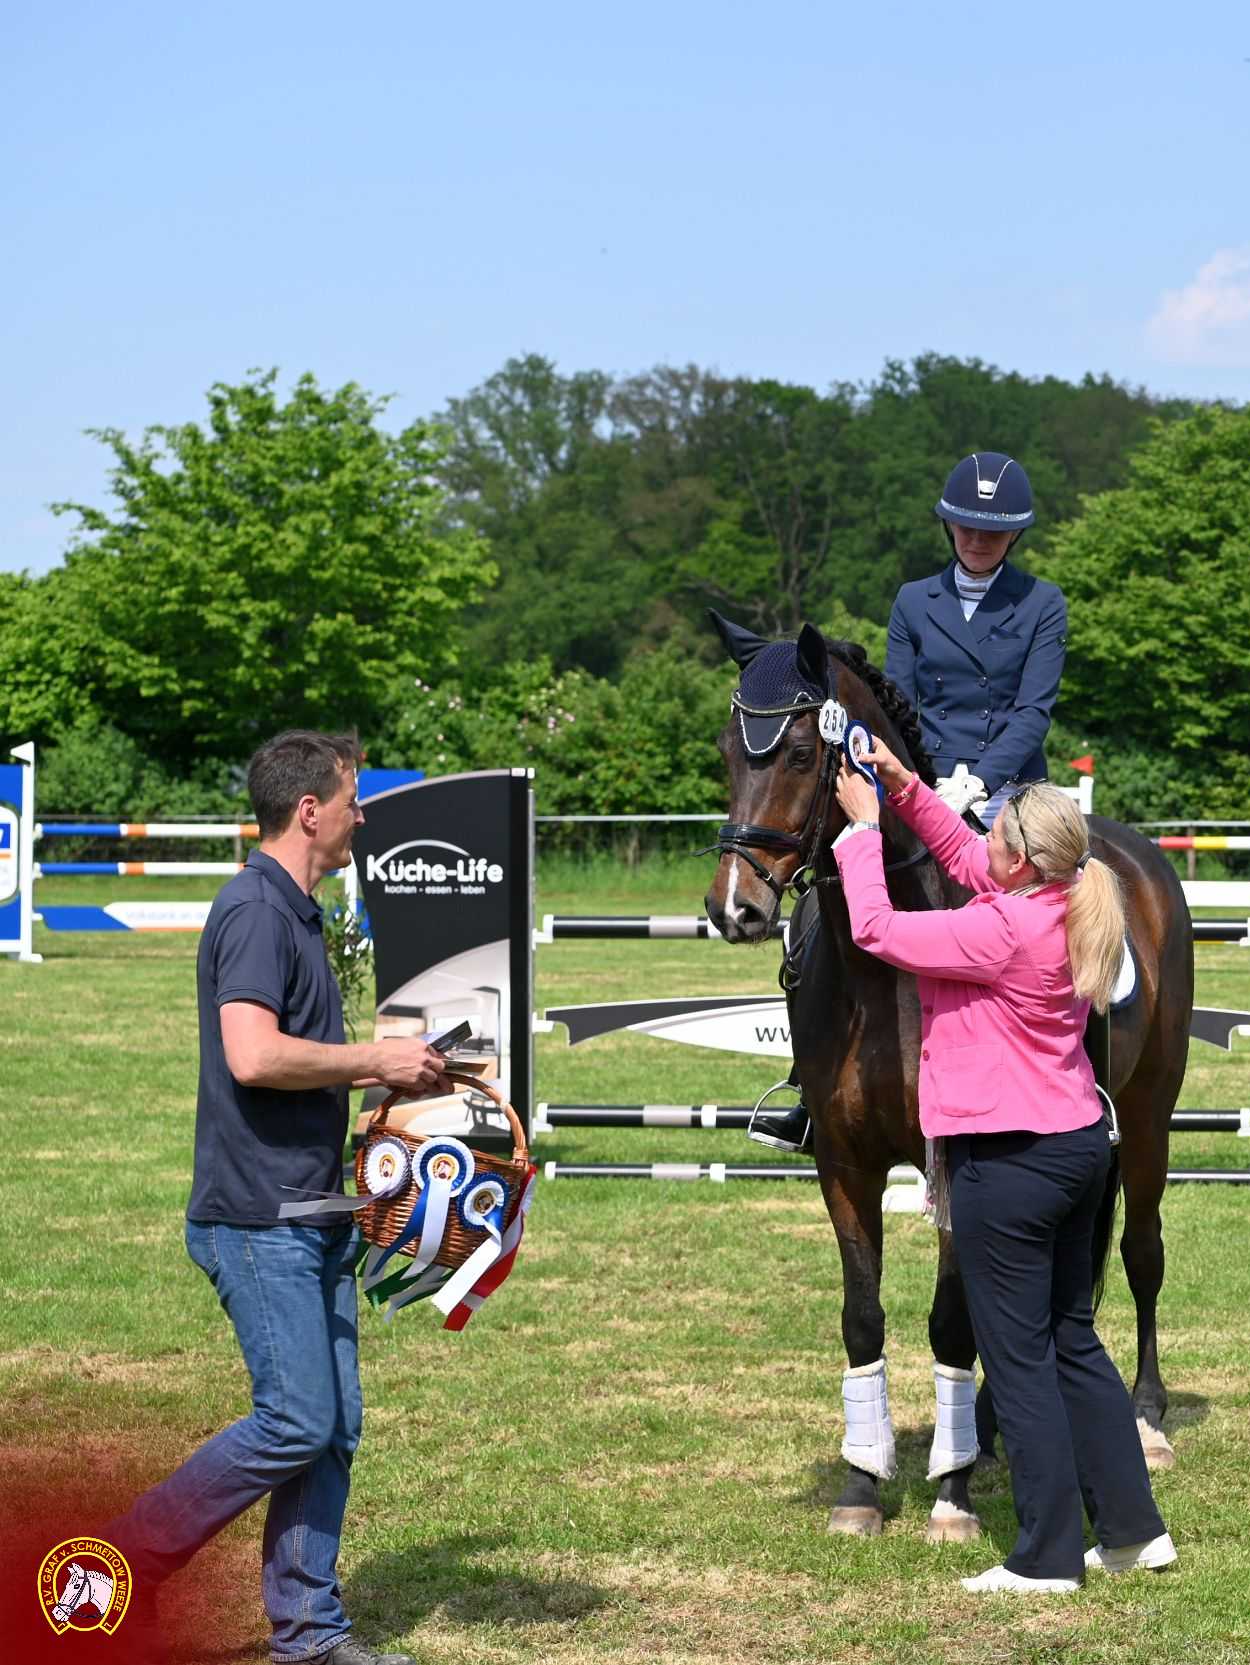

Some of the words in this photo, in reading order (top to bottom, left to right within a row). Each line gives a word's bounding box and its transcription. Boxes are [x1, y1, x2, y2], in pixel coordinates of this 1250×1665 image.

[824, 709, 845, 733] 254
[366, 854, 504, 883] Küche-Life
[384, 884, 417, 895] kochen
[425, 886, 452, 895] essen
[460, 885, 486, 895] leben
